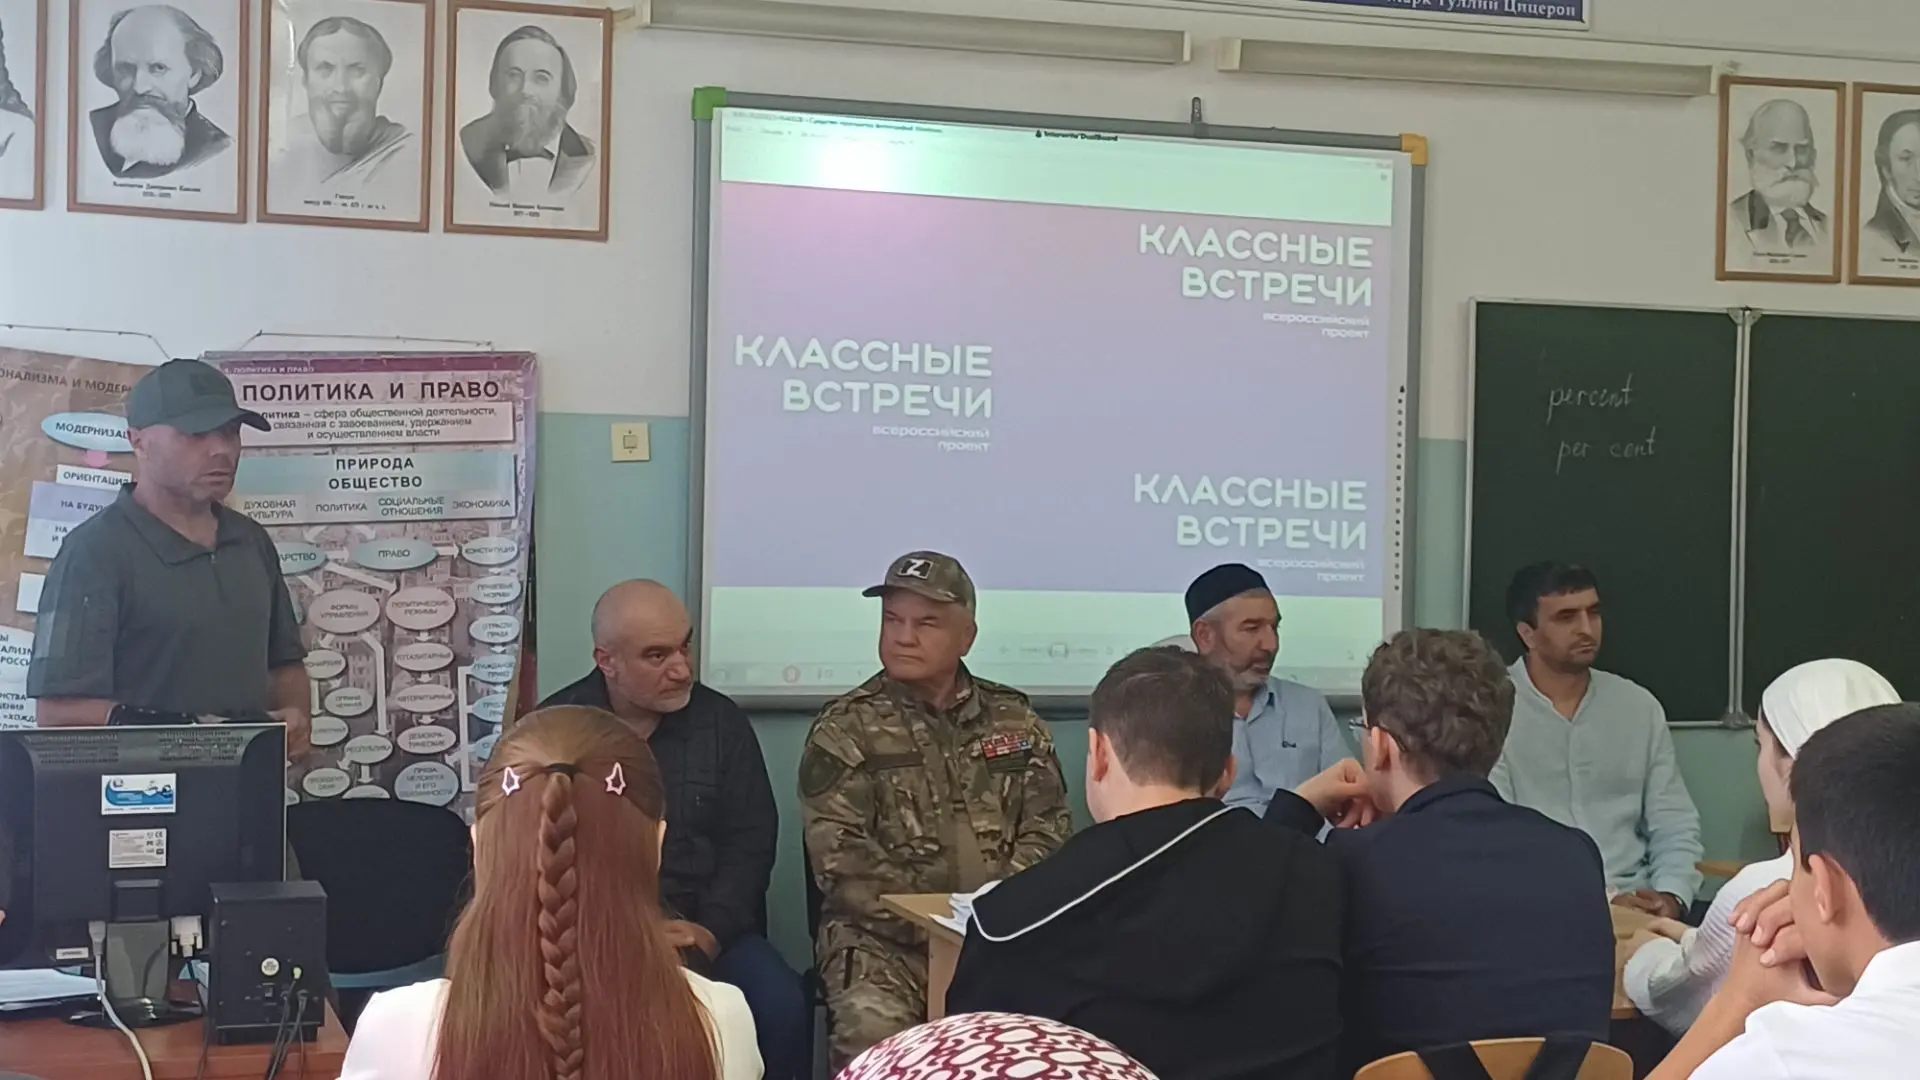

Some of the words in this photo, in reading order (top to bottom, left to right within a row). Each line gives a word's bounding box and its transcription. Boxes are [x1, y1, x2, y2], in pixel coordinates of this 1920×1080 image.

[1504, 2, 1576, 17] Цицерон
[1139, 223, 1374, 267] КЛАССНЫЕ
[1181, 266, 1373, 307] ВСТРЕЧИ
[1262, 312, 1370, 326] всероссийский
[1321, 327, 1370, 339] проект
[735, 334, 993, 377] КЛАССНЫЕ
[72, 378, 82, 388] И
[243, 383, 373, 402] ПОЛИТИКА
[390, 382, 404, 400] И
[421, 381, 499, 400] ПРАВО
[782, 379, 993, 418] ВСТРЕЧИ
[1546, 372, 1634, 426] percent
[261, 411, 300, 419] литика
[314, 409, 347, 420] сфера
[350, 407, 423, 419] общественной
[426, 407, 497, 418] деятельности,
[273, 421, 327, 430] связанная
[338, 419, 408, 429] завоеванием,
[410, 418, 472, 430] удержанием
[317, 430, 403, 441] осуществлением
[406, 429, 441, 437] власти
[872, 425, 991, 438] всероссийский
[937, 440, 991, 452] проект
[1556, 439, 1592, 476] per
[1610, 425, 1656, 459] cent
[336, 457, 415, 471] ПРИРОДА
[328, 475, 423, 491] ОБЩЕСТВО
[1133, 473, 1368, 512] КЛАССНЫЕ
[61, 500, 73, 509] НА
[243, 500, 296, 510] ДУХОВНАЯ
[316, 503, 367, 512] ПОЛИТИКА
[378, 496, 445, 506] СОЦИАЛЬНЫЕ
[452, 499, 511, 510] ЭКОНОМИКА
[381, 506, 444, 516] ОТНОШЕНИЯ
[1176, 514, 1367, 551] ВСТРЕЧИ
[378, 549, 410, 558] ПРАВО
[899, 559, 923, 577] Z
[1316, 571, 1365, 583] проект
